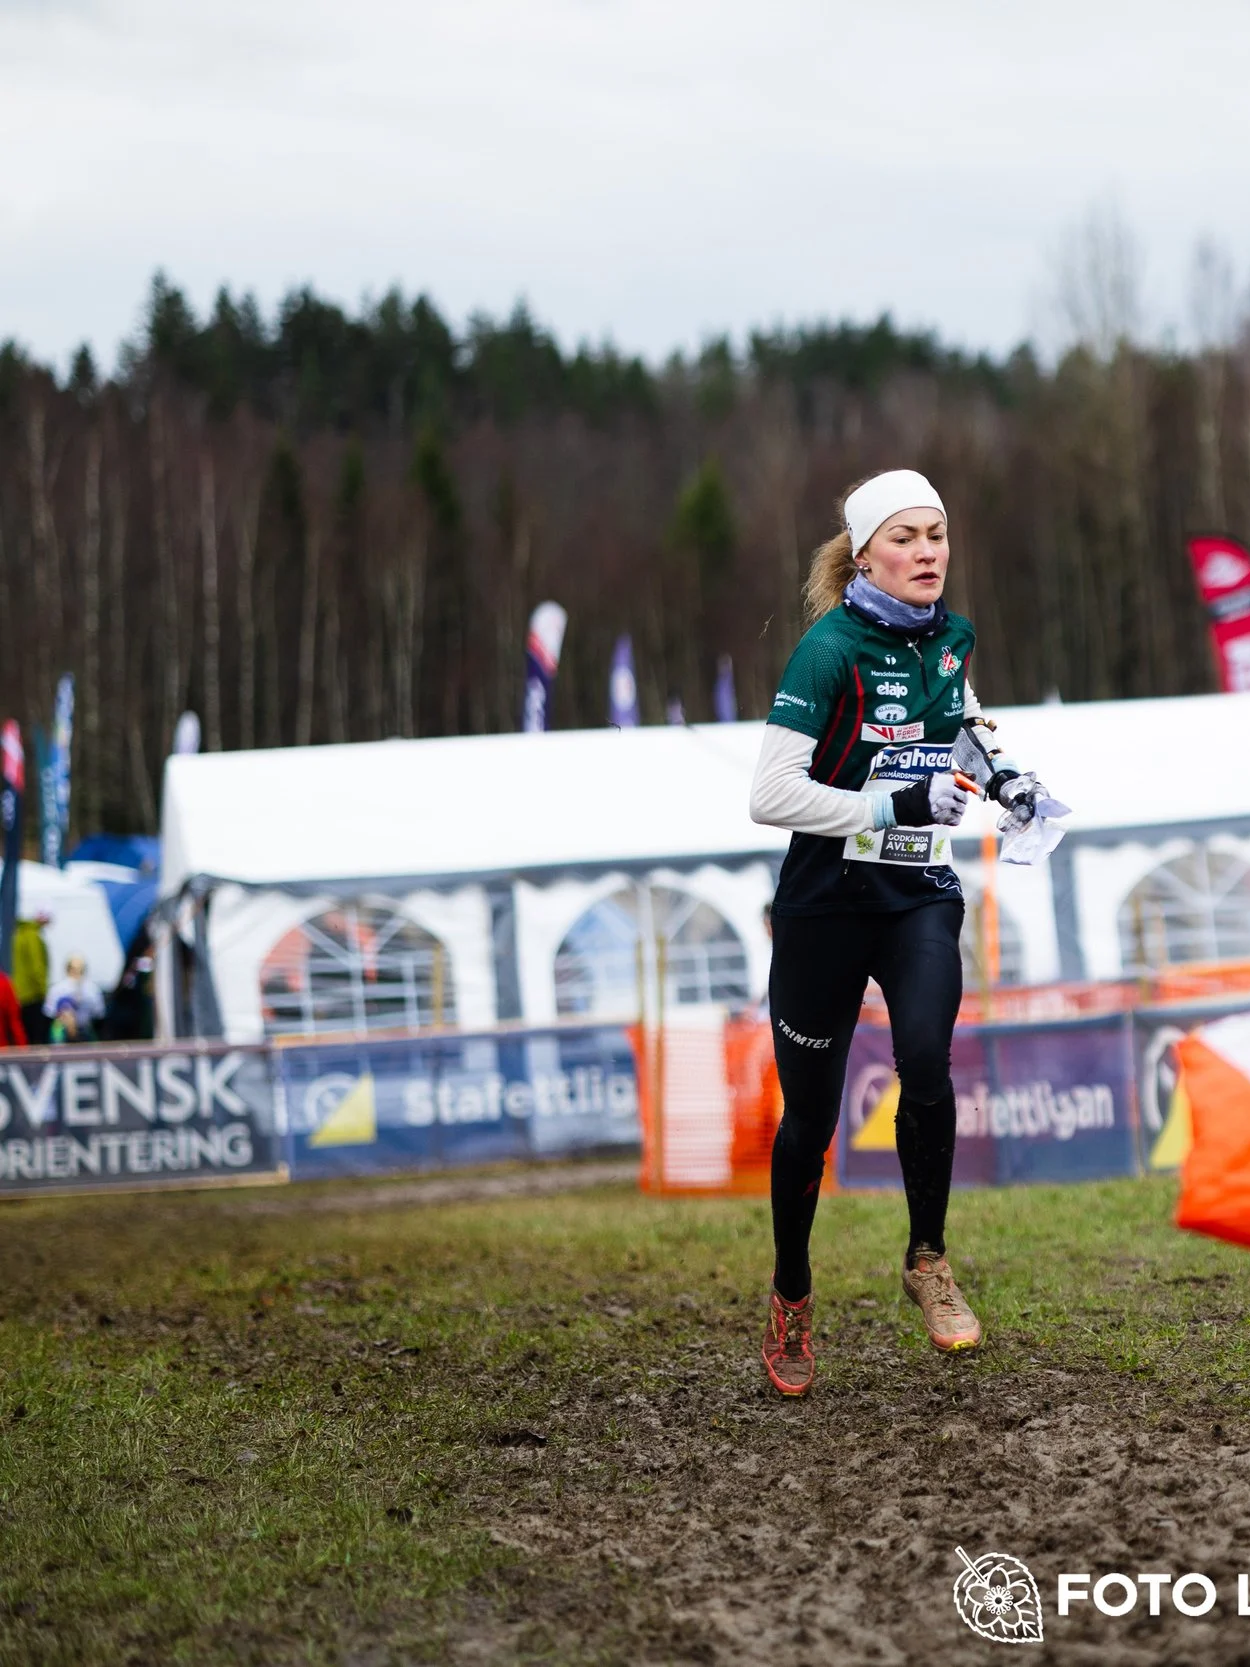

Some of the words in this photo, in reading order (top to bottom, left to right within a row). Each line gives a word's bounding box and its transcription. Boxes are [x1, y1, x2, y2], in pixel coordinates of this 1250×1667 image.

[876, 682, 908, 698] elajo
[876, 748, 952, 769] bagheer
[886, 841, 927, 852] AVLOPP
[888, 834, 928, 843] GODKÄNDA
[778, 1019, 832, 1049] TRIMTEX
[956, 1081, 1114, 1141] afettligan
[0, 1122, 253, 1180] RIENTERING
